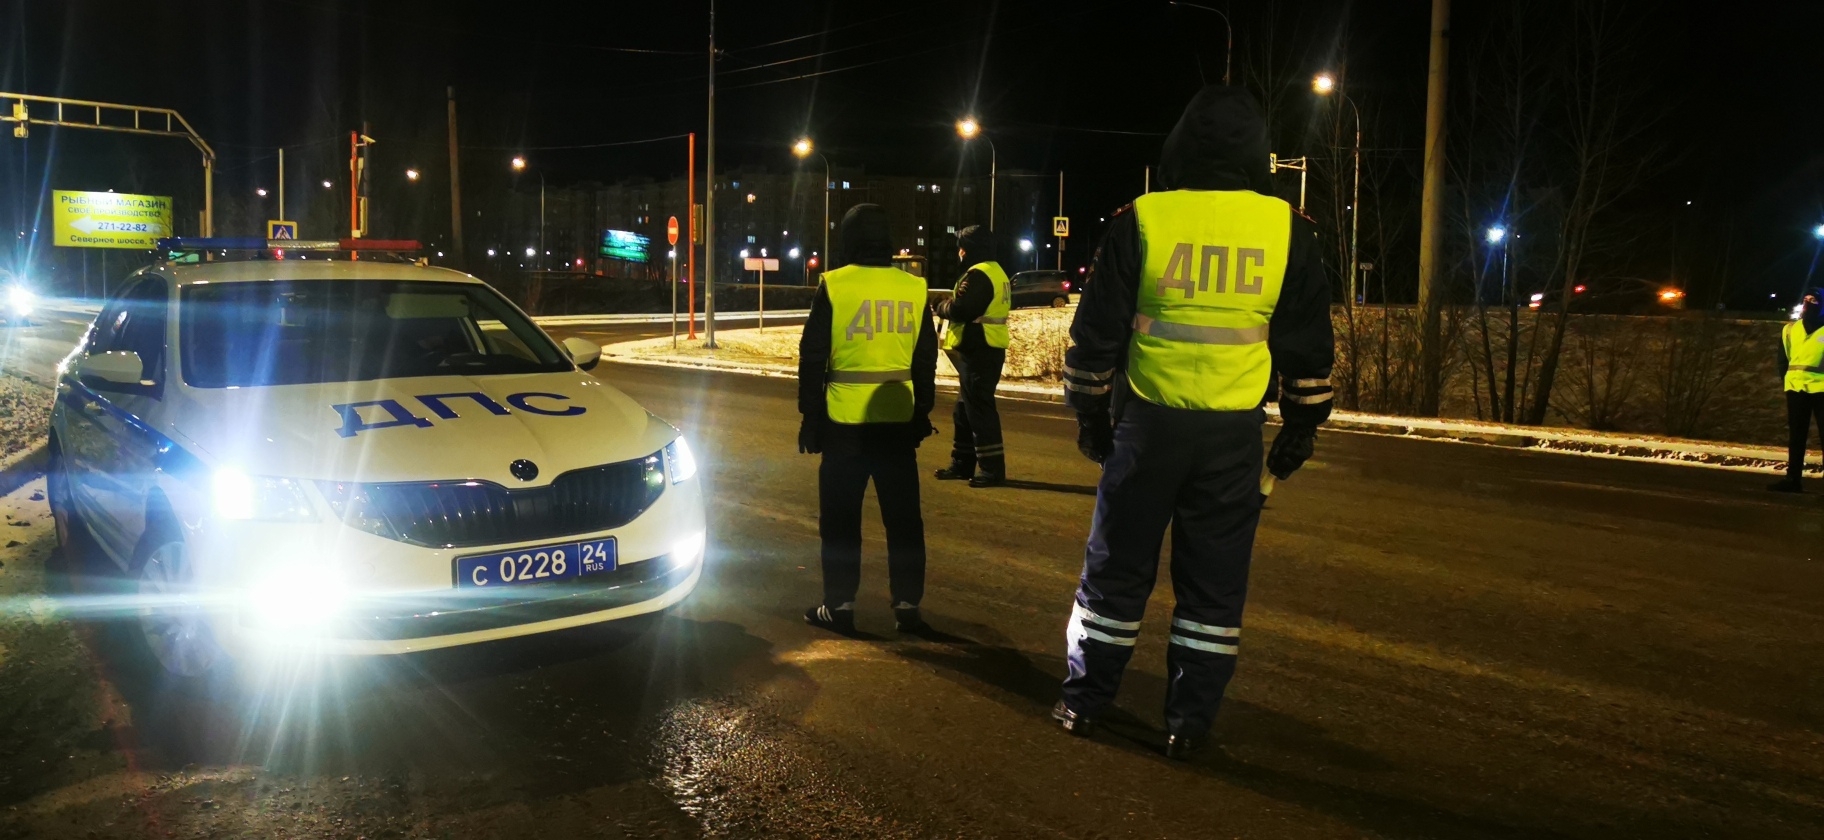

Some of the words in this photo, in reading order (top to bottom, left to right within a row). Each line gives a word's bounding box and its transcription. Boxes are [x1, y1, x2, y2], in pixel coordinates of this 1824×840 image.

[61, 195, 112, 206] РЫБНЫЙ
[116, 199, 166, 210] МАГАЗИН
[93, 208, 161, 218] ПРОИЗВОДСТВО
[97, 221, 147, 232] 271-22-82
[70, 234, 115, 244] Северное
[1156, 242, 1265, 299] ДПС
[845, 299, 914, 341] ДПС
[329, 391, 587, 439] ДПС
[499, 549, 567, 583] 0228
[582, 542, 607, 565] 24
[585, 562, 604, 572] RUS
